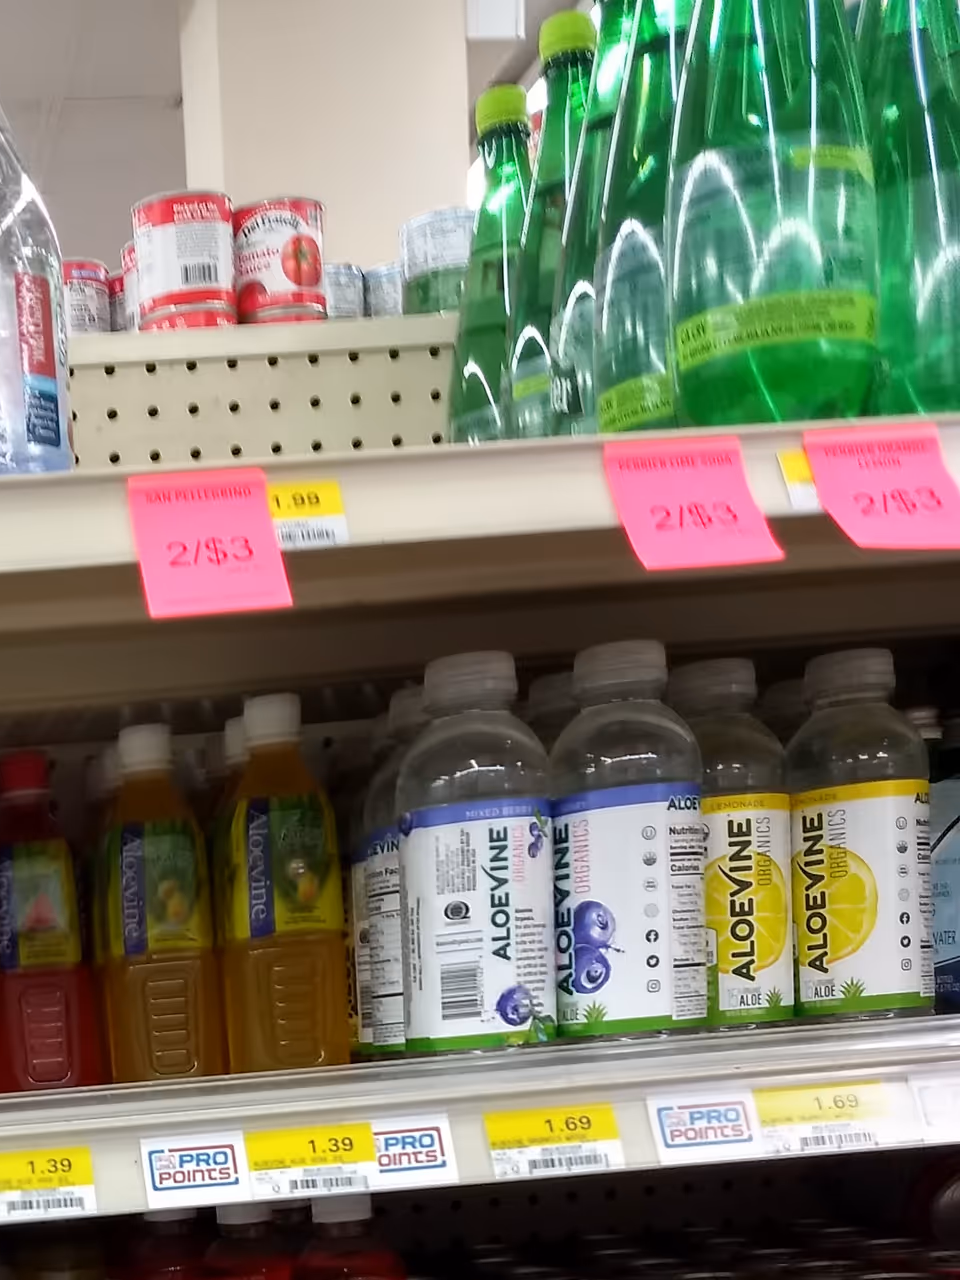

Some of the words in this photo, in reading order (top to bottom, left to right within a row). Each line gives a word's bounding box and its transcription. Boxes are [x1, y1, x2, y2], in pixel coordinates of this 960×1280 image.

[852, 486, 944, 517] 2/$3
[648, 501, 739, 533] 2/$3
[167, 534, 257, 569] 2/$3
[710, 799, 767, 811] LEMONADE
[572, 818, 591, 895] ORGANICS
[756, 815, 772, 887] ORGANICS
[827, 808, 849, 880] ORGANICS
[246, 808, 271, 921] Aloevine
[121, 832, 144, 937] Aloevine
[481, 825, 512, 962] ALOEVINE
[796, 811, 830, 975] ALOEVINE
[553, 821, 575, 997] ALOEVINE
[718, 816, 757, 982] ALOEVINE
[738, 992, 763, 1008] ALOE
[813, 983, 837, 999] ALOE
[812, 1092, 861, 1112] 1.69
[544, 1114, 592, 1134] 1.69
[688, 1105, 741, 1126] PRO
[307, 1136, 355, 1155] 1.39
[383, 1132, 437, 1151] PRO
[668, 1123, 745, 1143] POINTS
[26, 1157, 73, 1177] 1.39
[177, 1150, 230, 1169] PRO
[158, 1166, 232, 1185] POINTS
